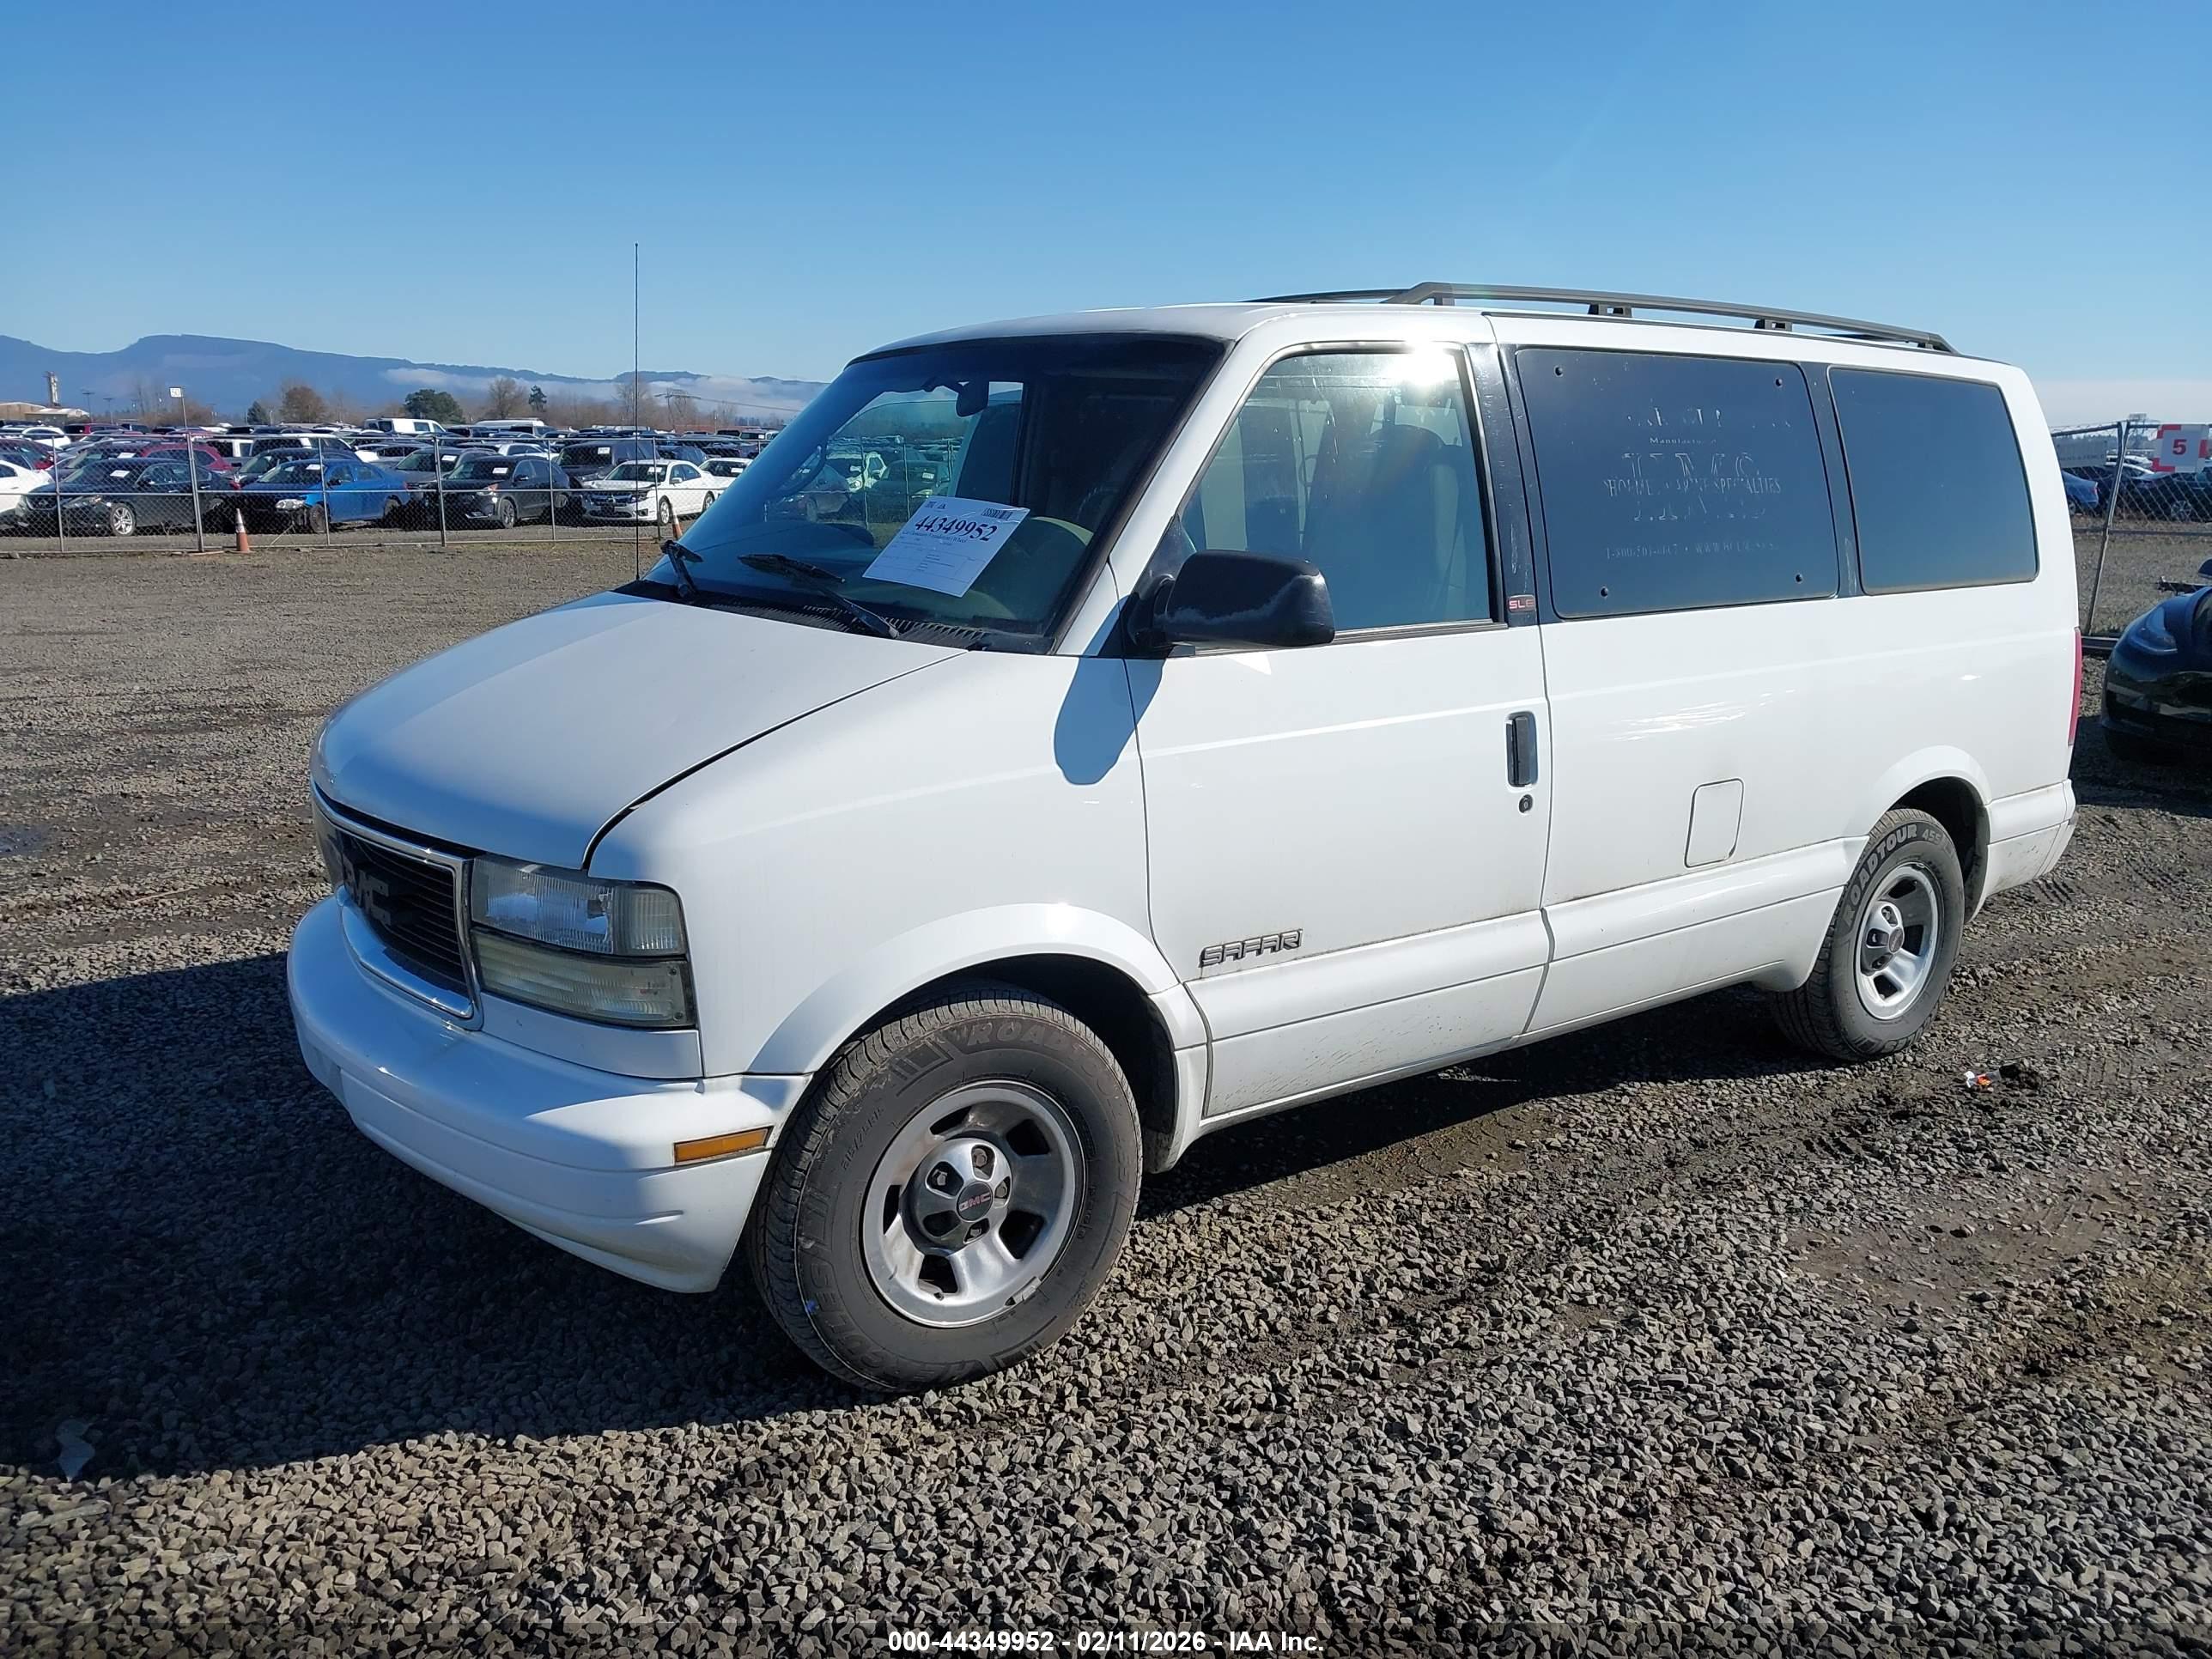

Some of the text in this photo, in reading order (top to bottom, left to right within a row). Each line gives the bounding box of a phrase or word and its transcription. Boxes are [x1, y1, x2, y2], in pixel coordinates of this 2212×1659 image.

[2172, 439, 2187, 455] 5
[915, 515, 998, 542] 44349952
[1509, 599, 1534, 610] SLE
[1841, 823, 1943, 927] ROADTOUR 455
[1198, 927, 1304, 968] SAFARI
[958, 1191, 992, 1212] GMC
